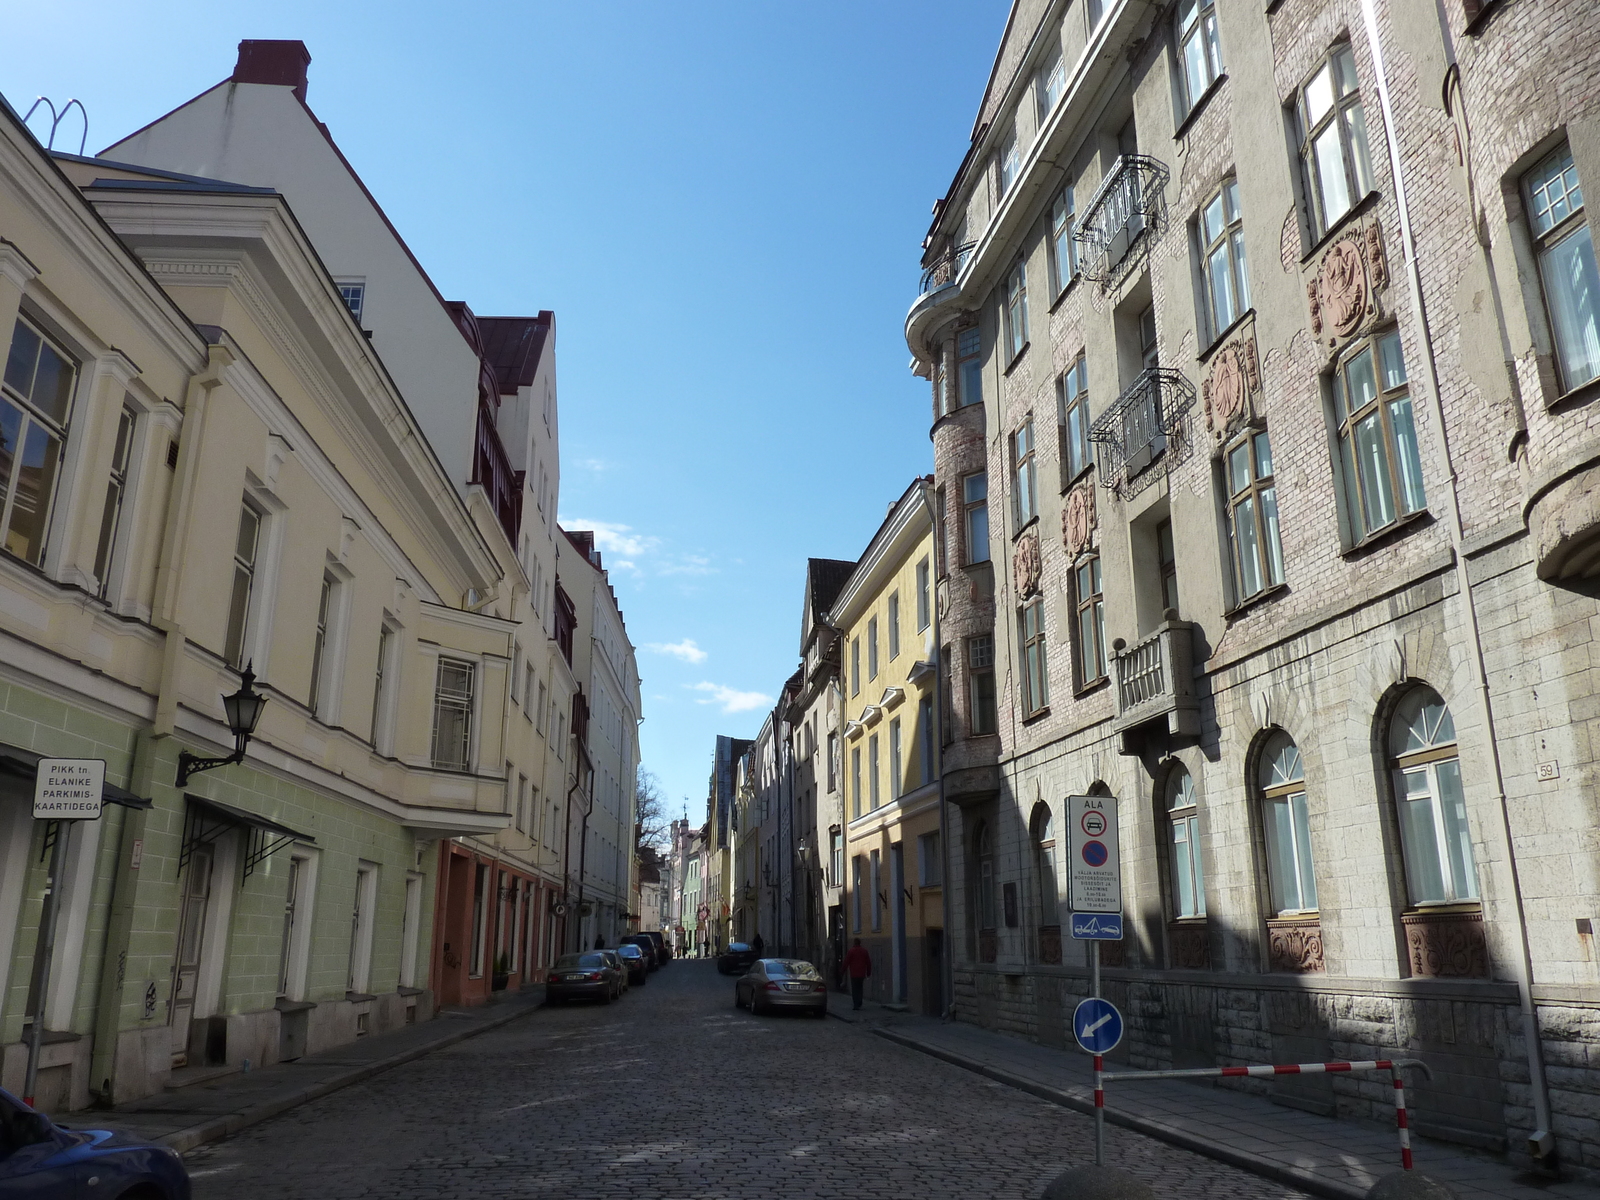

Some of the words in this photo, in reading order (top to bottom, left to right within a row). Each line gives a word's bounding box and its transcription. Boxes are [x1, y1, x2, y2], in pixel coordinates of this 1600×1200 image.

[51, 765, 74, 774] PIKK
[1540, 764, 1552, 776] 59
[48, 778, 91, 786] ELANIKE
[42, 790, 94, 798] PARKIMIS-
[34, 802, 99, 811] KAARTIDEGA
[1084, 800, 1103, 809] ALA
